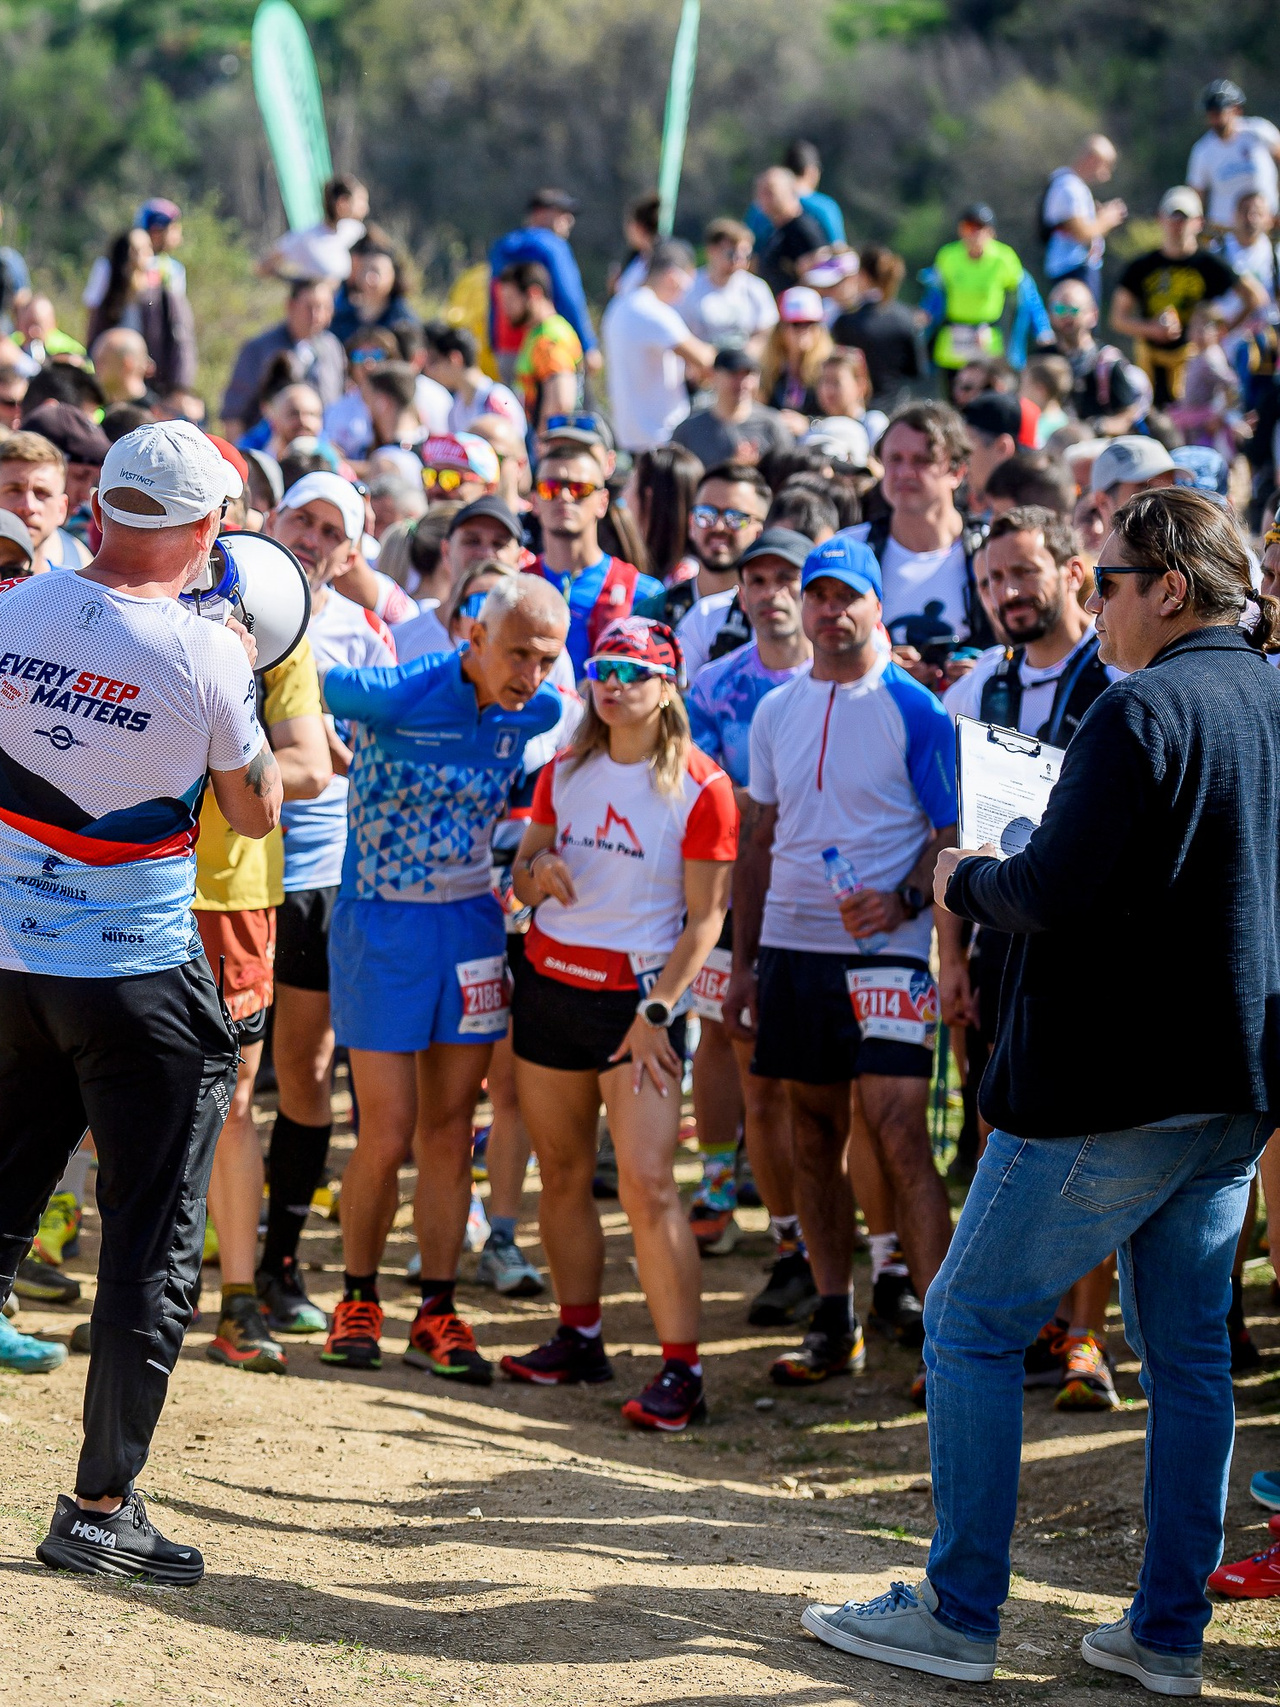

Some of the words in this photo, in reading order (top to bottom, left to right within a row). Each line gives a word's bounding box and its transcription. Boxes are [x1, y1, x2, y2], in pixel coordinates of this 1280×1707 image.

[72, 671, 141, 704] STEP
[30, 685, 152, 732] MATTERS
[15, 876, 61, 893] PLOVDIV
[60, 884, 87, 901] HILLS
[544, 956, 608, 982] SALOMON
[467, 983, 502, 1013] 2186
[857, 991, 901, 1016] 2114
[70, 1520, 117, 1549] HOKA
